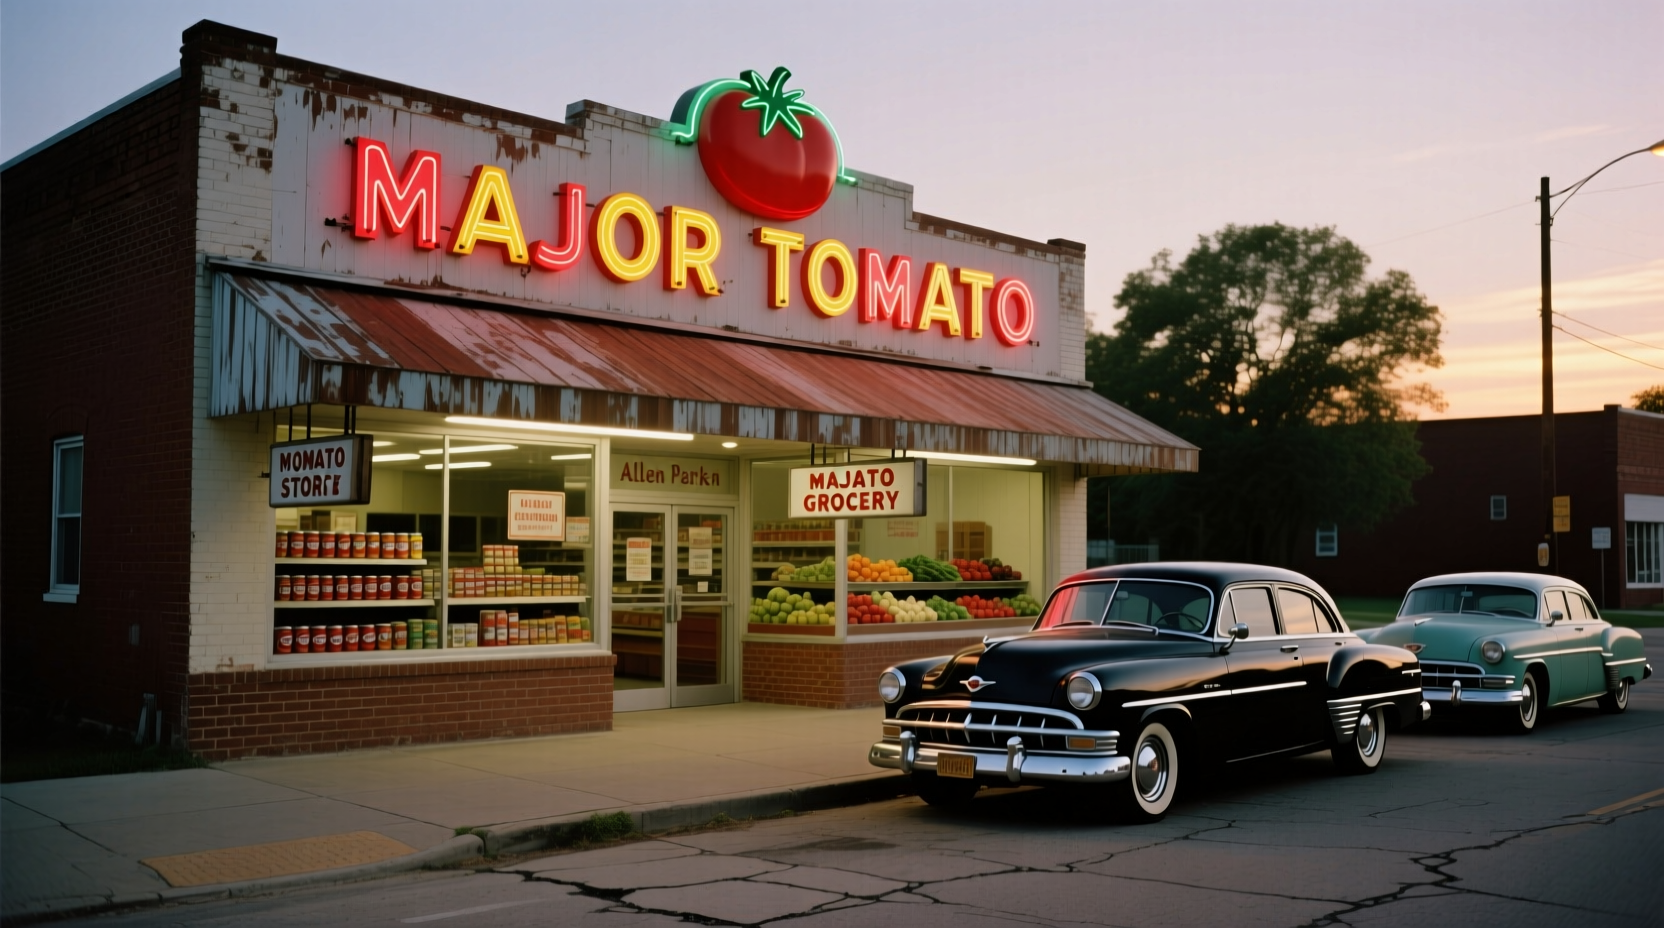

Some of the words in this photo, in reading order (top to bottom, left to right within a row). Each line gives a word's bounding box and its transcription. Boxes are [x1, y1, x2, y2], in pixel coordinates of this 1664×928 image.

[354, 136, 722, 296] MAJOR
[752, 226, 1035, 347] TOMATO
[620, 461, 665, 484] Allen
[809, 467, 895, 490] MAJATO
[803, 490, 900, 512] GROCERY
